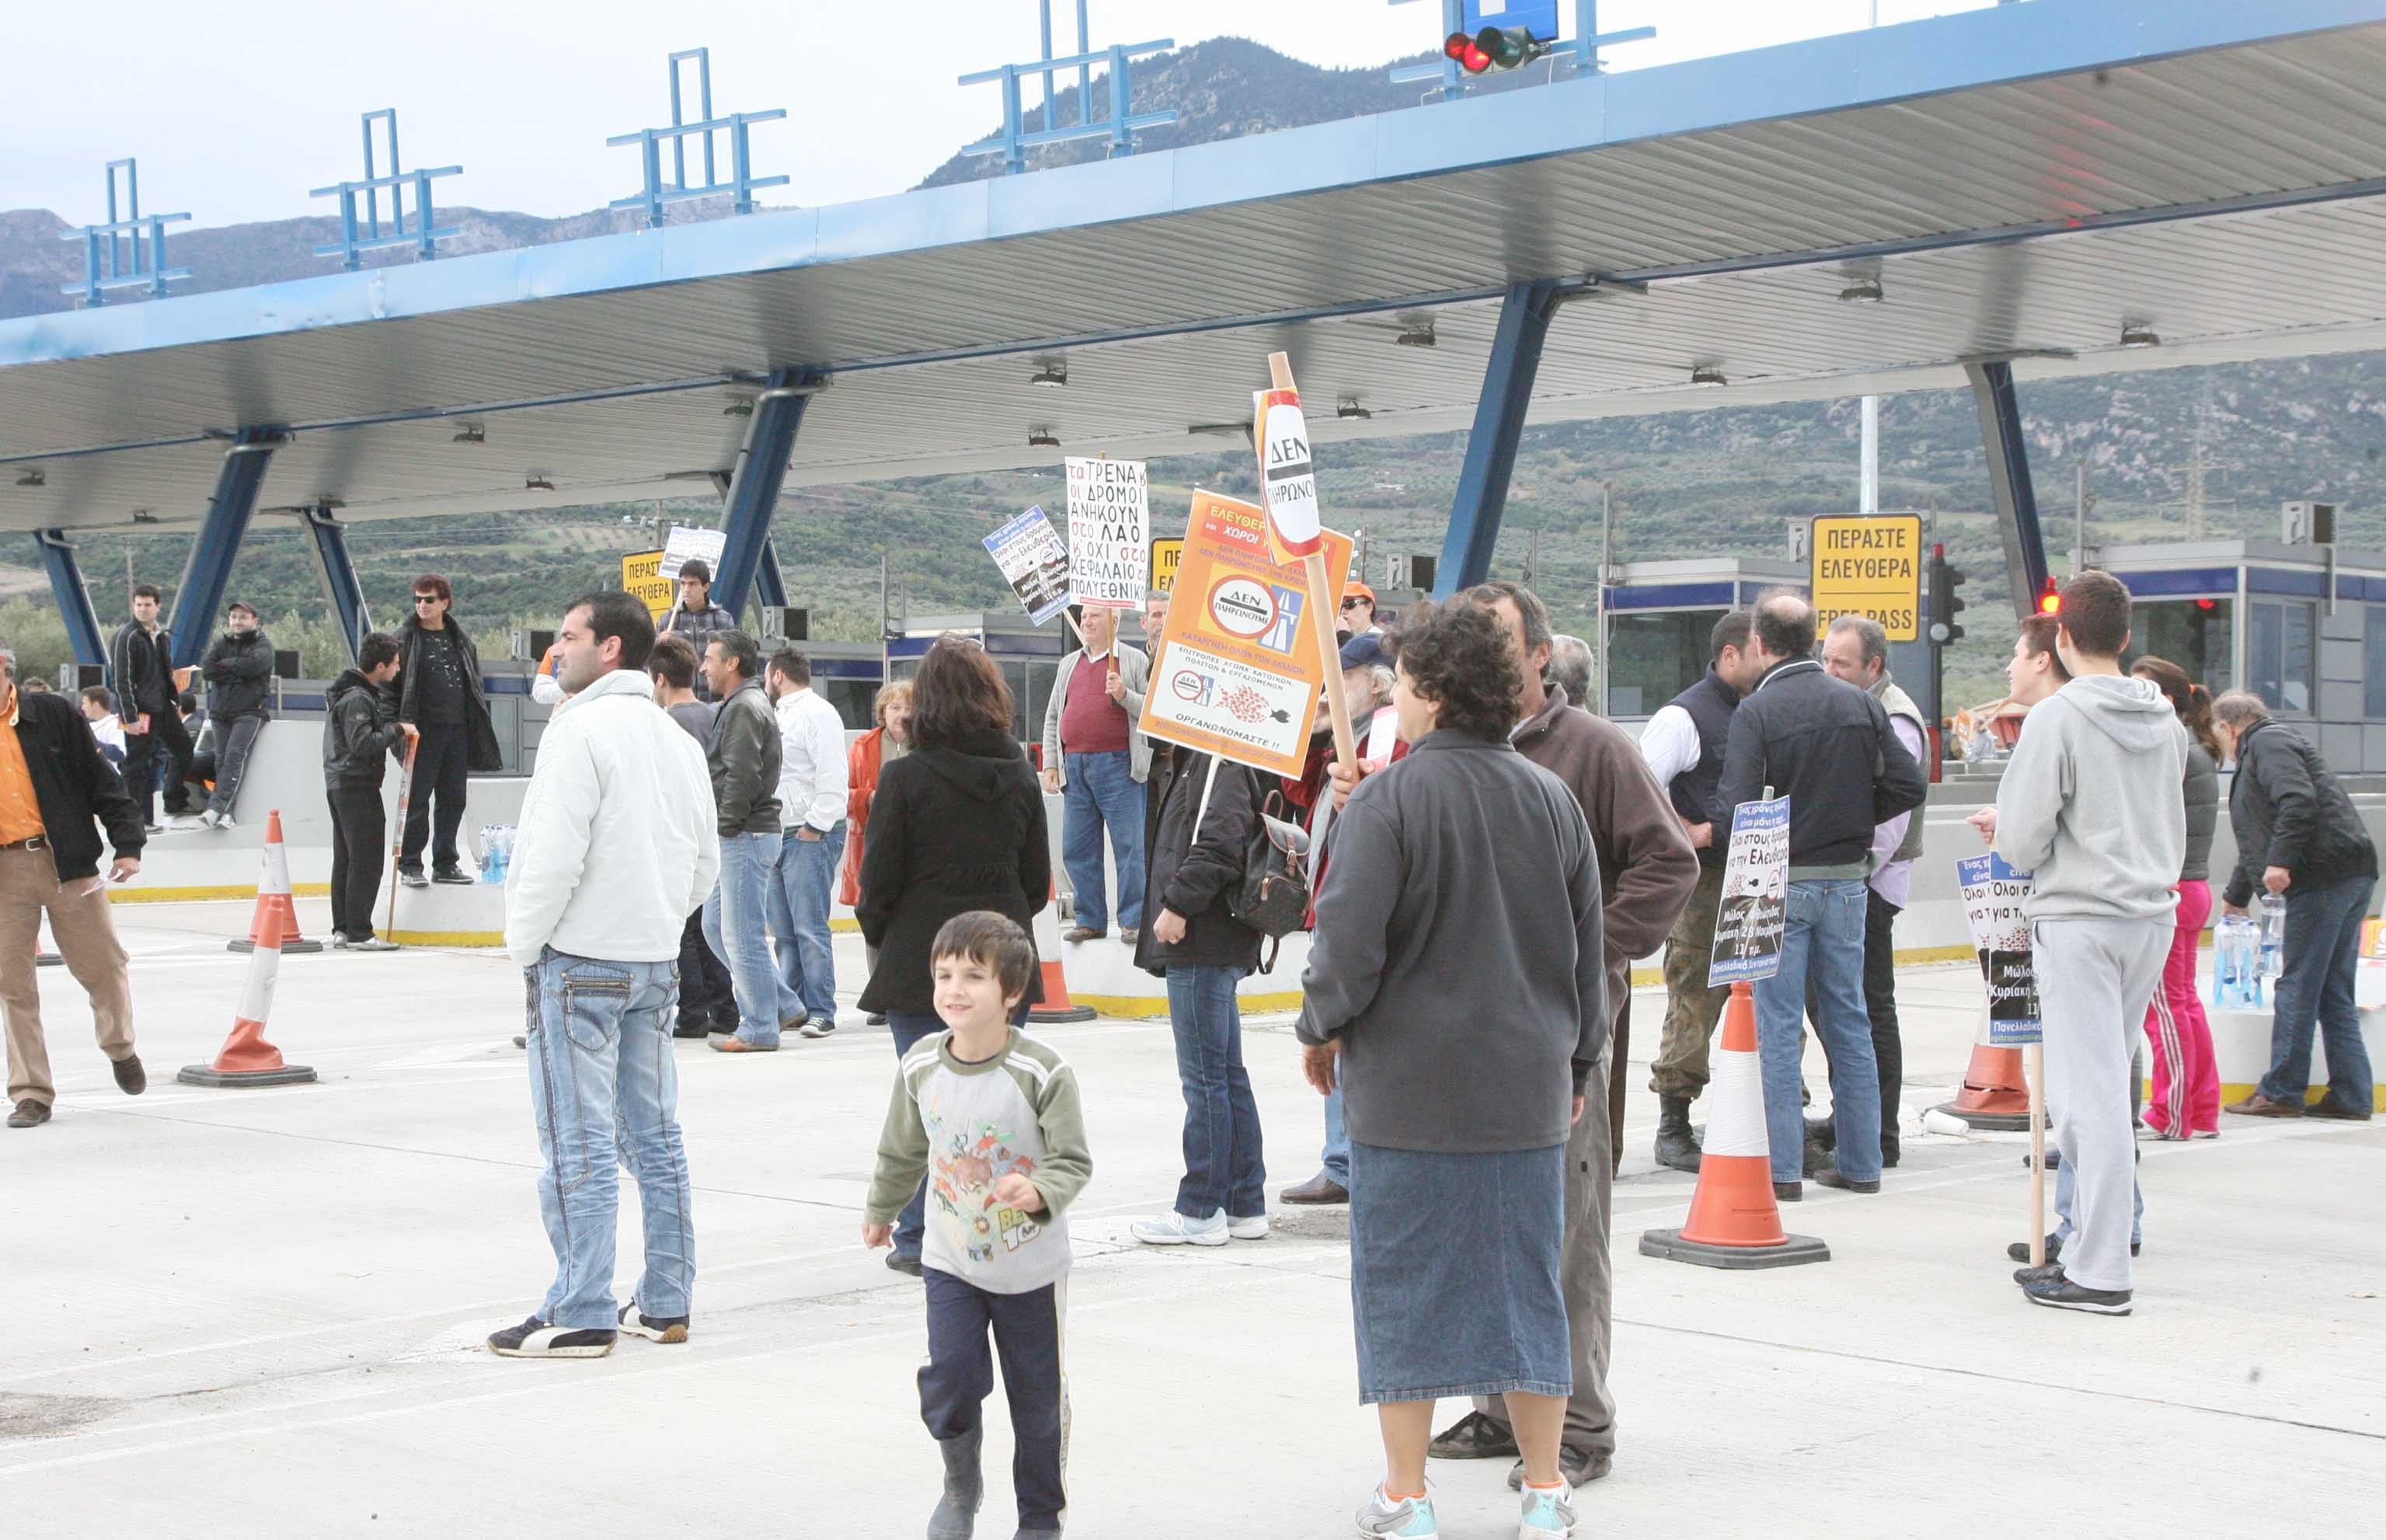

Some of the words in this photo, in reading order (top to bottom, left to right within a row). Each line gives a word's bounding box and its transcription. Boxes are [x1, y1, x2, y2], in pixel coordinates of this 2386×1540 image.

[1271, 437, 1308, 464] ΔΕΝ
[1068, 465, 1085, 479] τα
[1085, 461, 1137, 483] ΤΡΕΝΑ
[1088, 485, 1142, 504] ΔΡΟΜΟΙ
[1268, 479, 1313, 505] ΠΛΗΡΩΝΟ
[1071, 501, 1138, 524] ΑΝΗΚΟΥΝ
[1209, 505, 1267, 533] ΕΛΕΥΘΕΡ
[1102, 524, 1140, 543] ΛΑΟ
[1222, 524, 1259, 545] ΧΩΡΟΙ
[1827, 528, 1906, 549] ΠΕΡΑΣΤΕ
[1087, 542, 1109, 559] ΟΧΙ
[629, 560, 661, 579] ΠΕΡΑΣΤ
[1071, 558, 1135, 580] ΚΕΦΑΛΑΙΟ
[1820, 558, 1911, 579] ΕΛΕΥΘΕΡΑ
[1071, 578, 1145, 601] ΠΟΛΥΕΘΝΙΚΟ
[1231, 591, 1261, 607] ΔΕΝ
[1215, 602, 1270, 625] ΠΛΗΡΩΝΟΥΜΕ
[1176, 713, 1270, 747] ΟΡΓΑΝΩΝΟΜΑΣΤΕ
[1744, 834, 1770, 848] στους
[1750, 846, 1788, 865] Ελευθερία
[1973, 871, 1990, 881] είνα
[1962, 888, 1986, 901] Όλοι
[1991, 881, 2019, 897] Όλοι
[1968, 909, 1984, 925] για
[1992, 908, 2010, 923] για
[1741, 926, 1754, 939] 28
[1991, 983, 2031, 1000] Κυριακή
